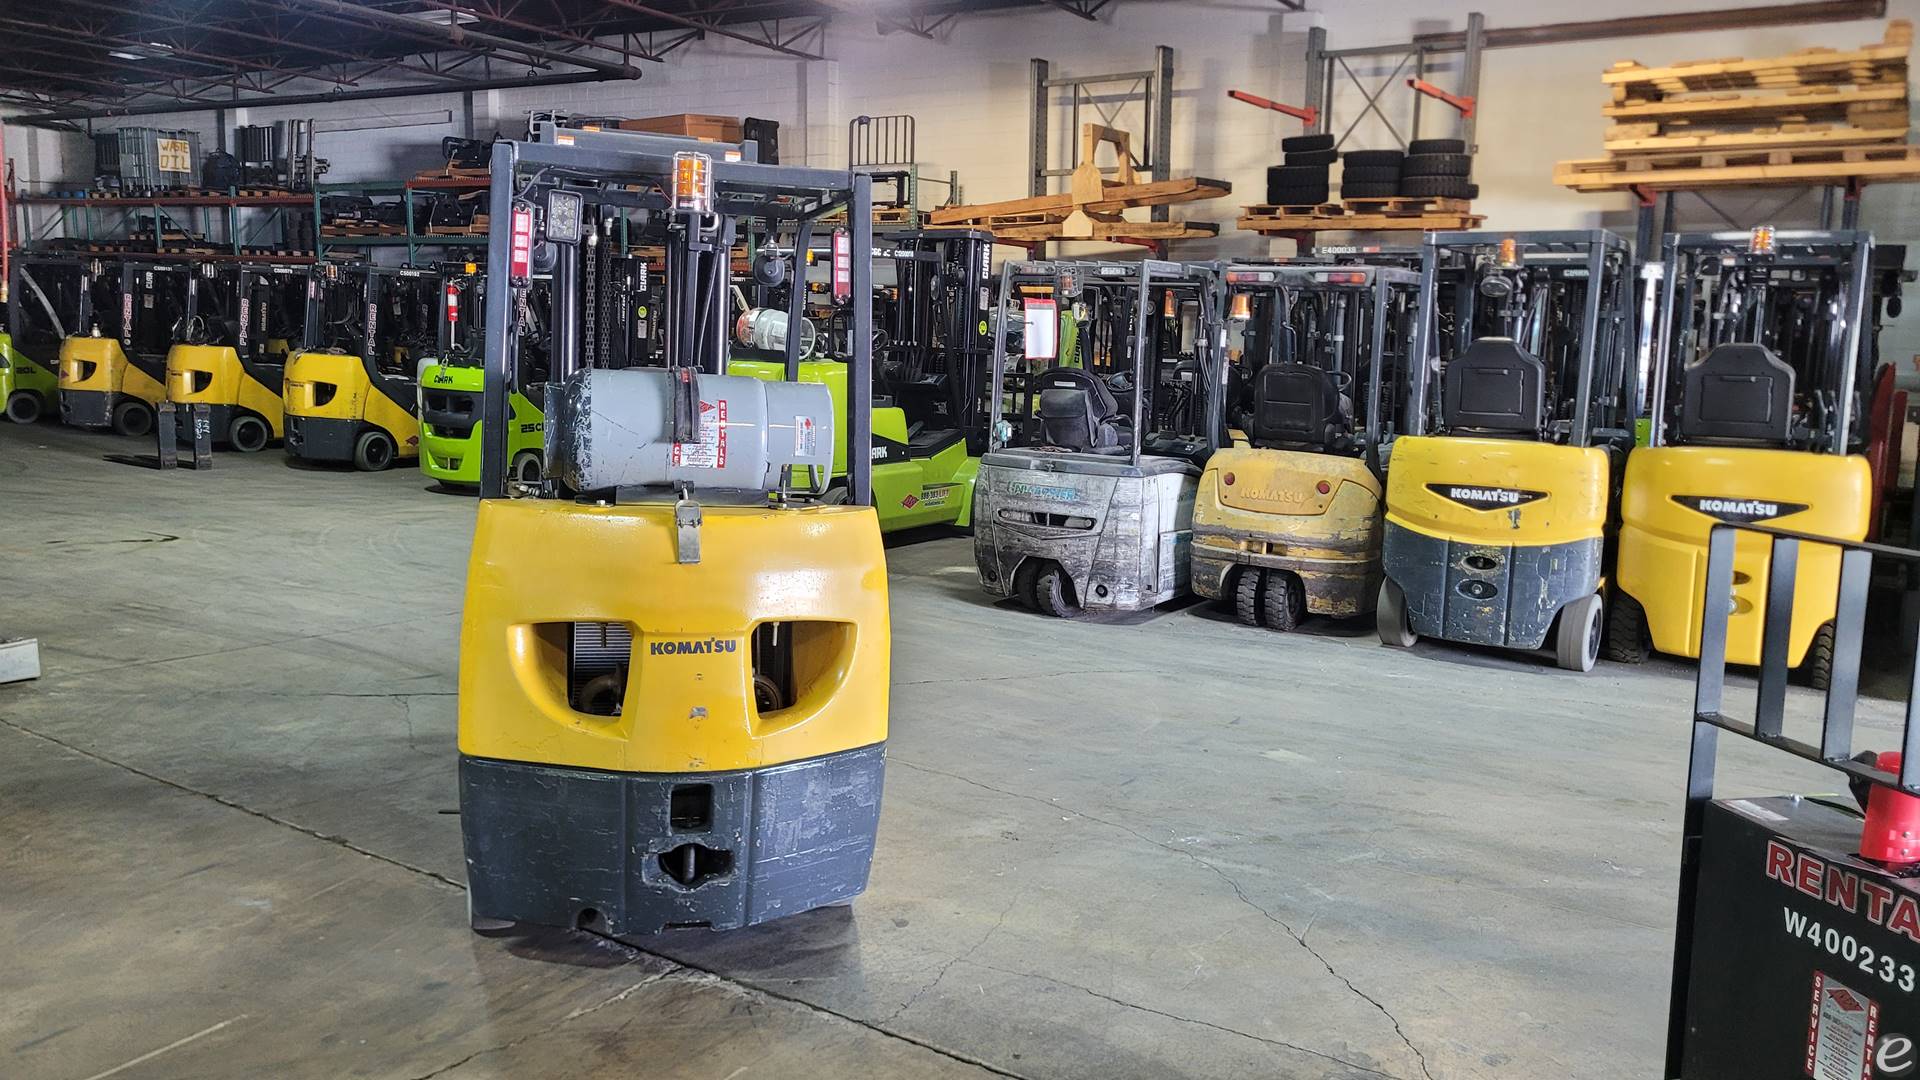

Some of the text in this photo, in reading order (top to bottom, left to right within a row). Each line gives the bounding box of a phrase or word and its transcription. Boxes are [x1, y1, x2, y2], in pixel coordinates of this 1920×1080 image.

[160, 154, 190, 169] OIL
[161, 142, 188, 153] WASTE
[640, 262, 648, 291] CLARK
[982, 243, 990, 279] CLARK
[145, 271, 153, 289] CLAR
[123, 293, 132, 338] RENTAL
[239, 298, 250, 346] RENTAL
[367, 303, 377, 356] RENTAL
[517, 287, 527, 336] ENTAL
[718, 402, 727, 465] RENTALS
[871, 446, 887, 459] ARK
[1240, 487, 1305, 504] KOMATSU
[1450, 488, 1519, 503] KOMATSU
[1699, 499, 1777, 516] KOMATSU
[650, 637, 736, 655] KOMATSU
[1766, 840, 1920, 944] RENTA
[1783, 907, 1915, 991] W400233
[1806, 976, 1822, 1071] SERVICE
[1863, 1005, 1877, 1080] RENTA
